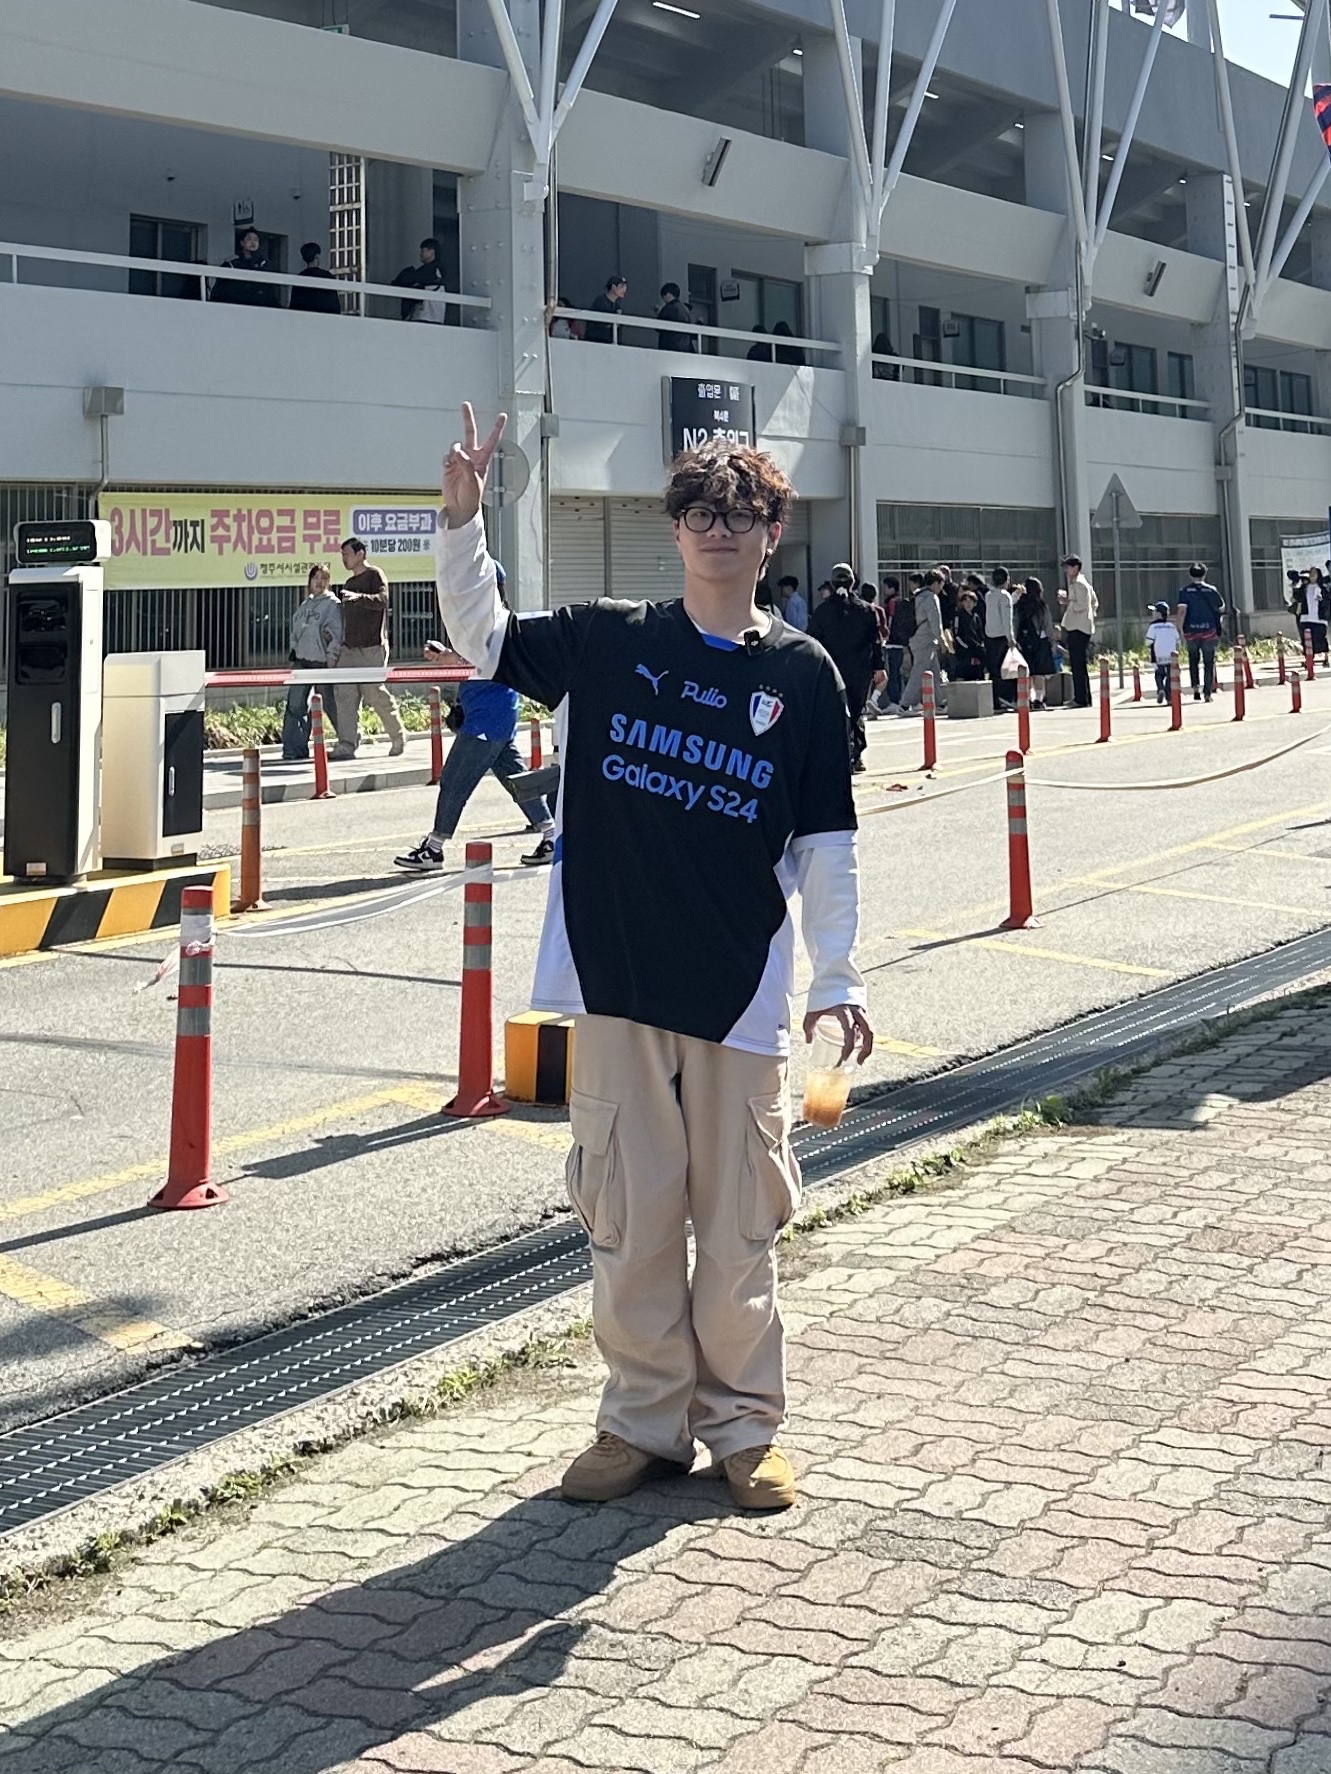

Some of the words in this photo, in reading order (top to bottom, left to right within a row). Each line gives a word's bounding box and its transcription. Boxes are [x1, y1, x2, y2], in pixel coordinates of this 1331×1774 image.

[683, 428, 708, 453] N2
[210, 508, 296, 556] 주차요금
[303, 509, 341, 554] 무료
[358, 513, 382, 532] 이후
[385, 512, 432, 532] 요금부과
[371, 538, 396, 553] 10분당
[398, 538, 421, 553] 200원
[609, 713, 774, 789] SAMSUNG
[602, 754, 705, 811] Galaxy
[707, 785, 758, 823] S24
